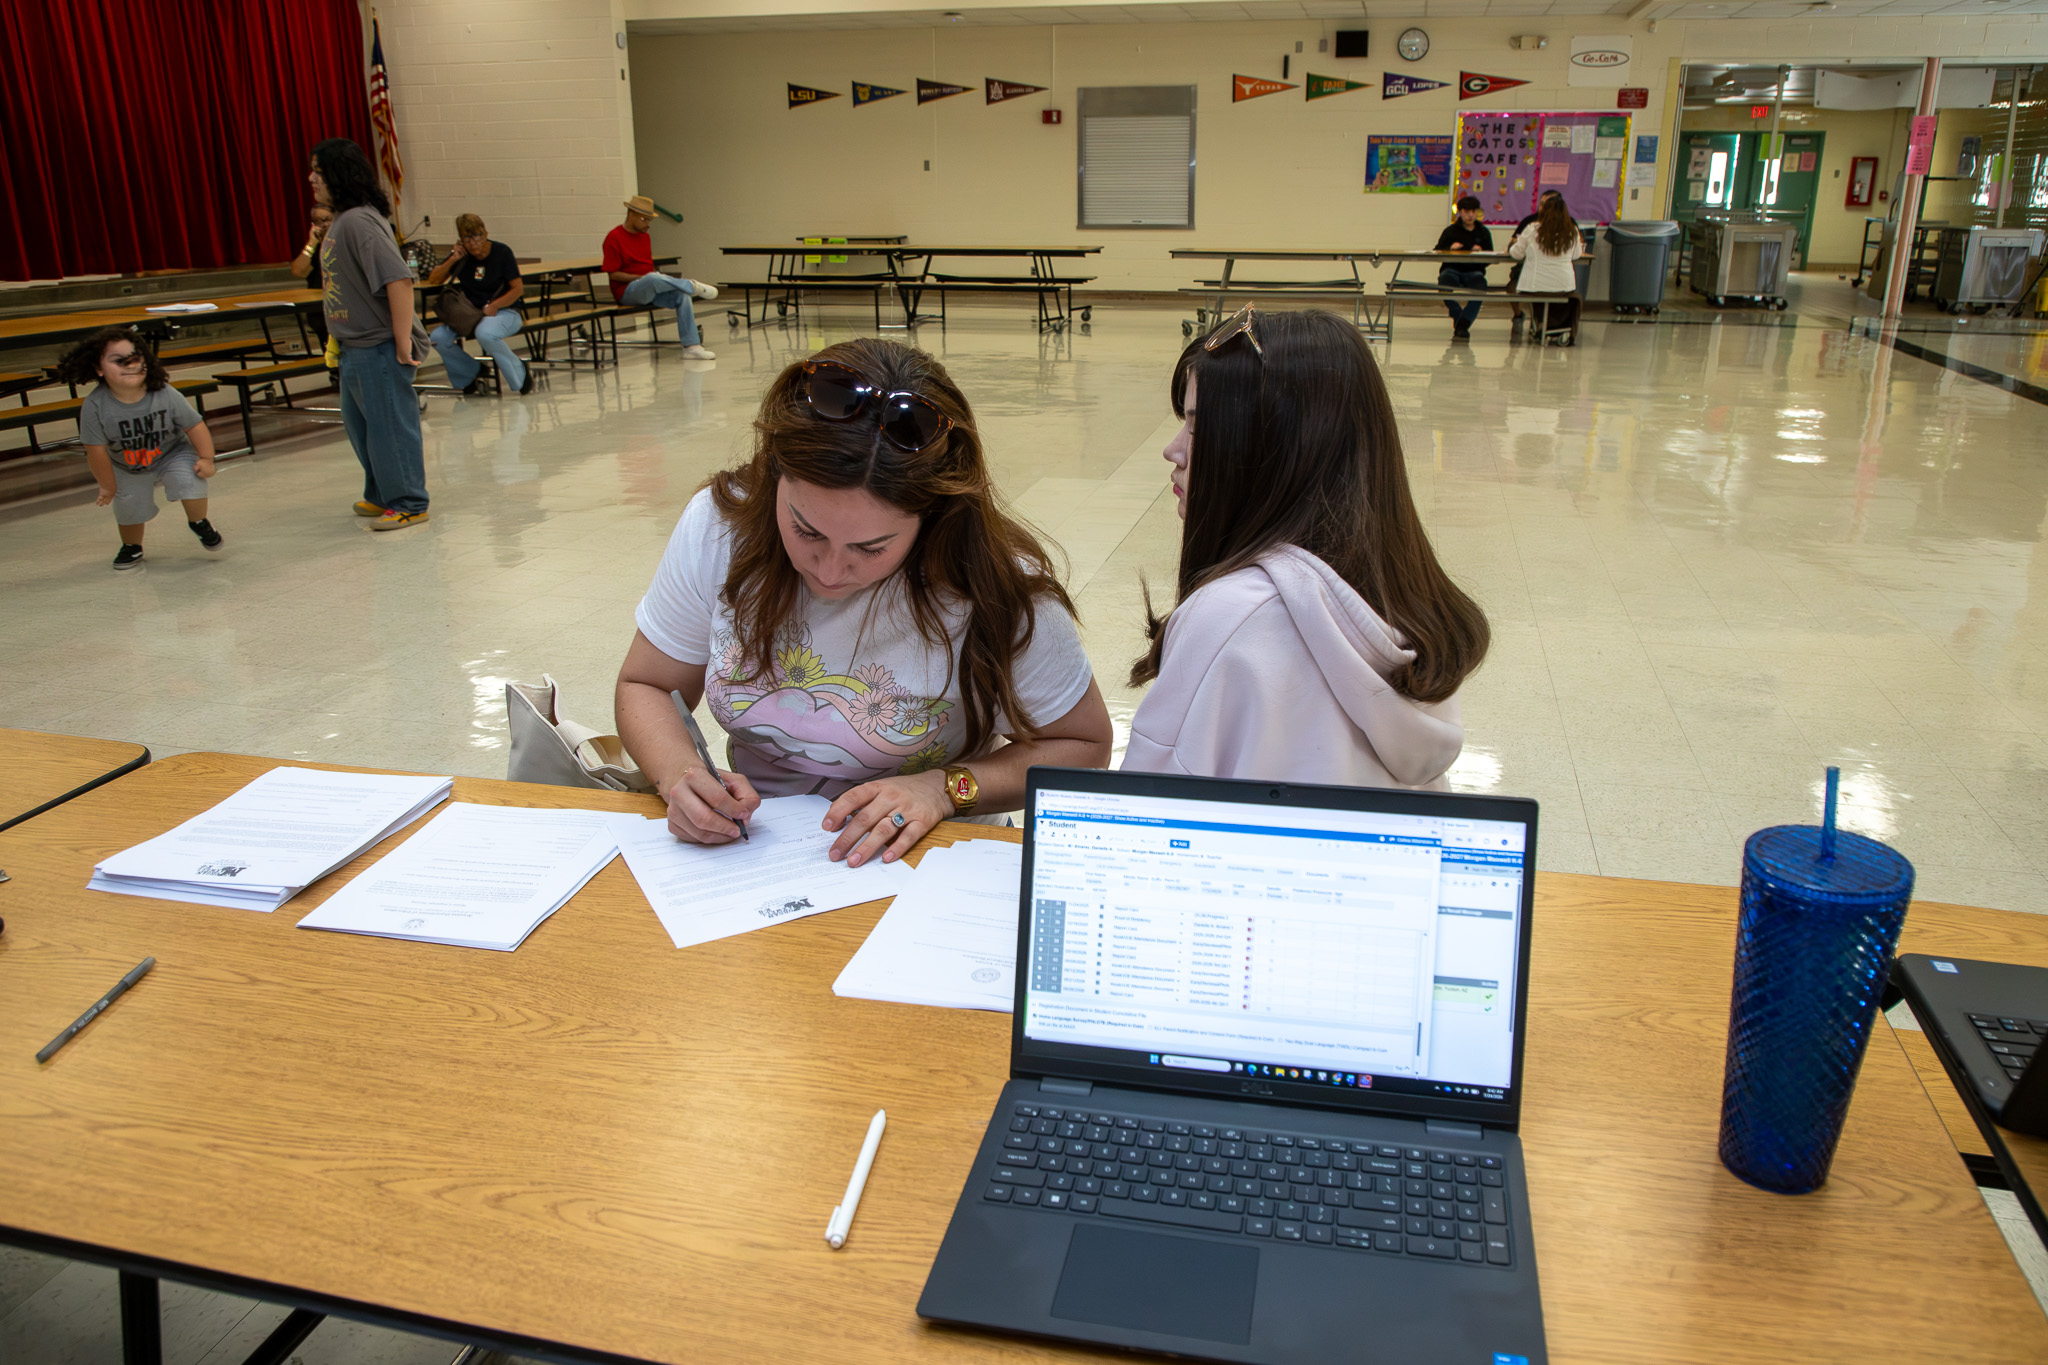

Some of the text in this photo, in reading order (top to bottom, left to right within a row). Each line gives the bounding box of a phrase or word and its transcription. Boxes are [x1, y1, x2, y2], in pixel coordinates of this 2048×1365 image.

[790, 90, 816, 100] LSU
[1386, 85, 1409, 95] GCU
[1751, 106, 1768, 118] EXIT
[1480, 123, 1515, 134] THE
[1467, 138, 1527, 149] GATOS
[1473, 153, 1517, 165] CAFE
[118, 409, 167, 439] CAN'T
[1048, 820, 1076, 829] Student
